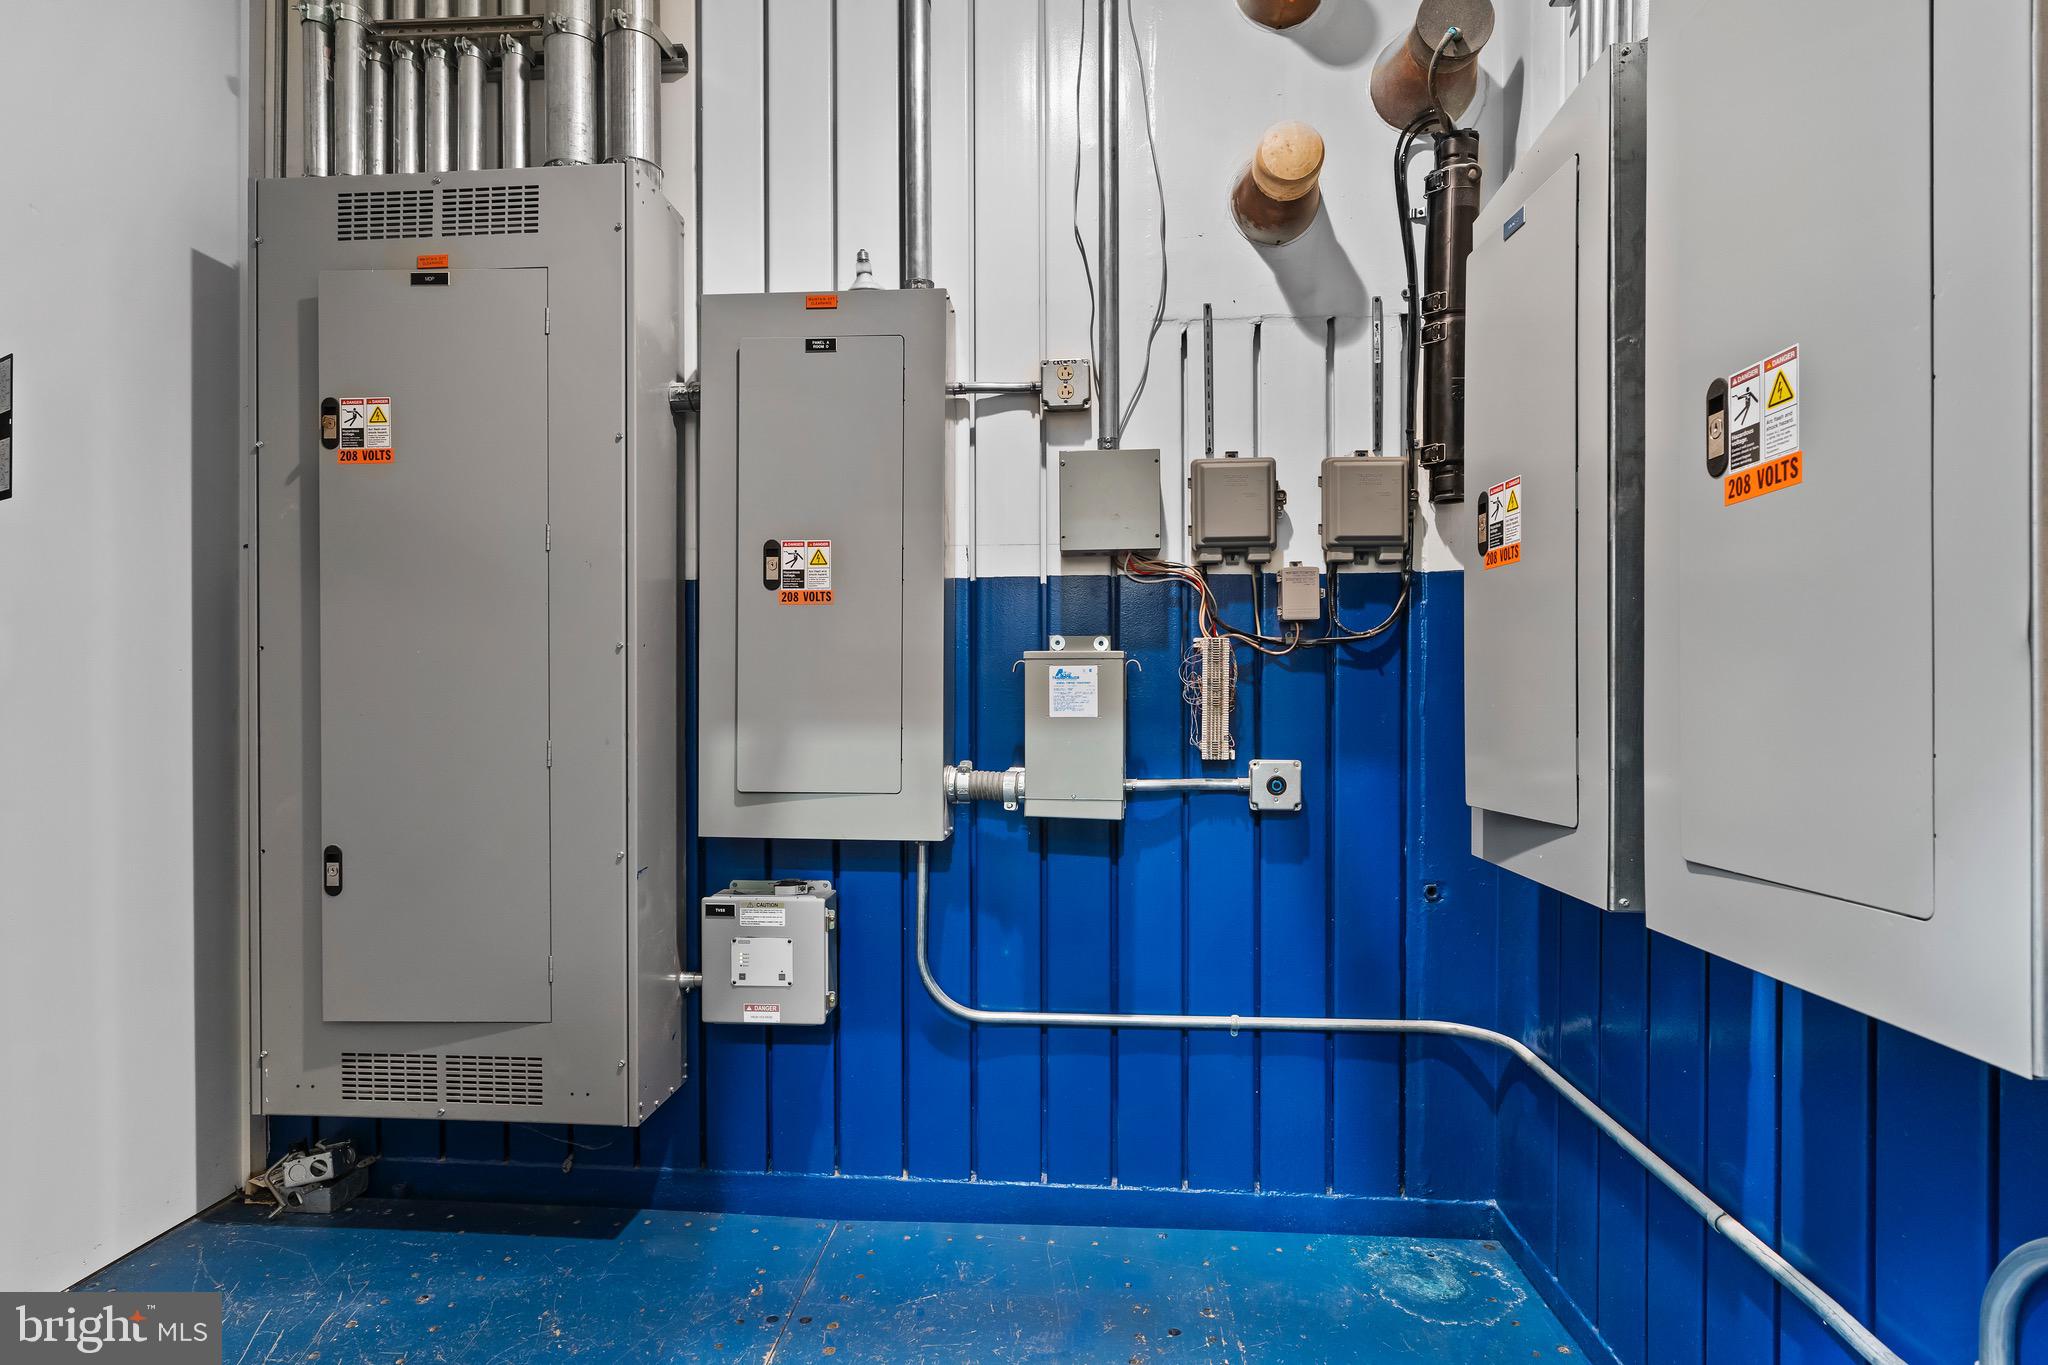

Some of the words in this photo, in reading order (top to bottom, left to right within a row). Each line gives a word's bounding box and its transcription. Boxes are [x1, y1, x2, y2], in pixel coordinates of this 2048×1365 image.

[1771, 350, 1796, 367] DANGER
[1737, 368, 1759, 383] DANGER
[340, 450, 358, 461] 208
[362, 449, 392, 461] VOLTS
[1728, 473, 1751, 500] 208
[1757, 456, 1799, 490] VOLTS
[1486, 550, 1498, 566] 208
[1500, 544, 1519, 562] VOLTS
[781, 591, 799, 602] 208
[803, 591, 832, 602] VOLTS
